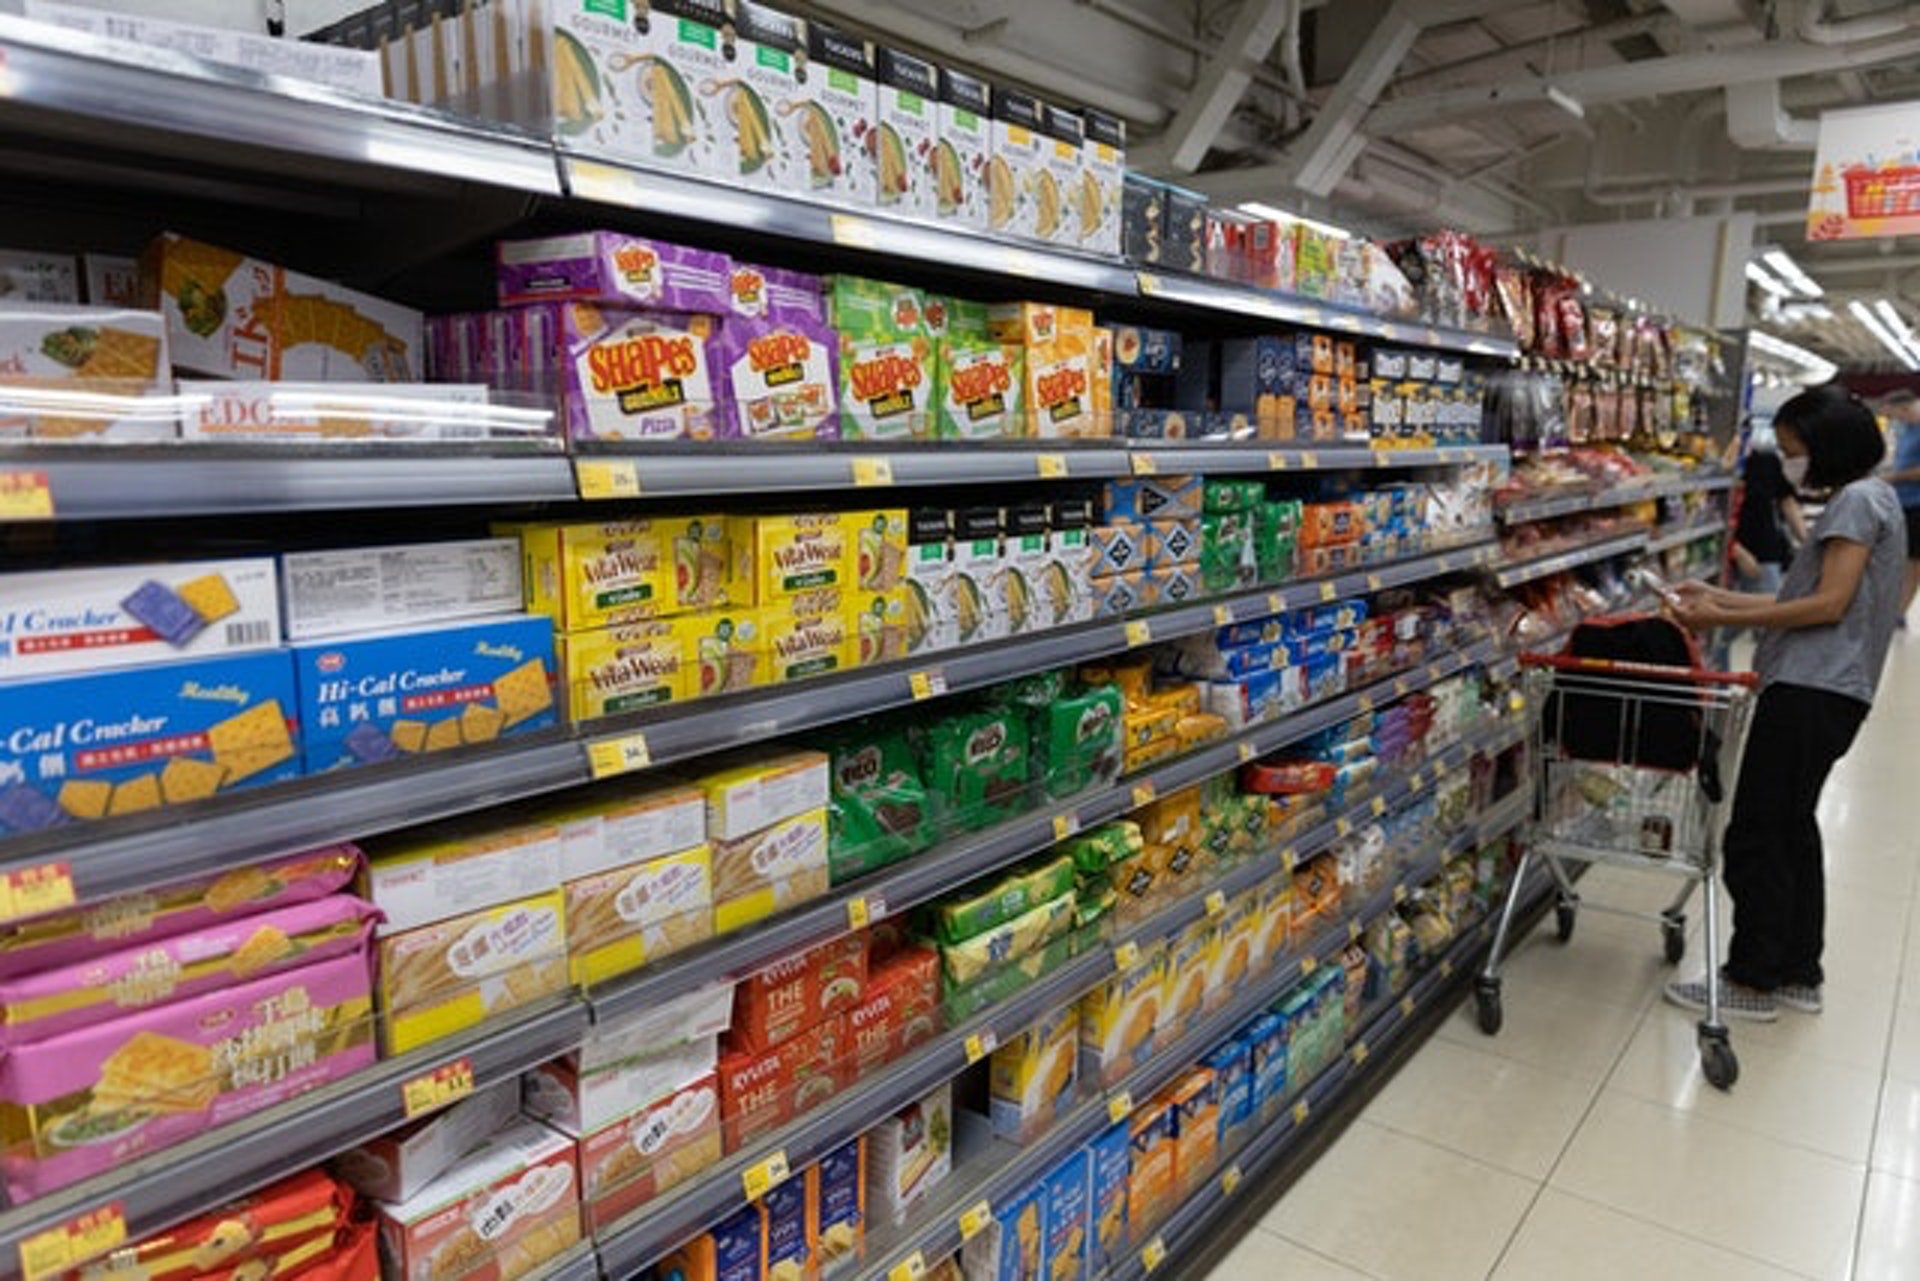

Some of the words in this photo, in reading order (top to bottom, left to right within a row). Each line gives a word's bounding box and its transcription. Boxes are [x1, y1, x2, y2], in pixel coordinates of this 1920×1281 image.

[318, 672, 397, 703] Hi-Cal
[400, 667, 467, 690] Cracker
[70, 714, 169, 745] Cracker
[767, 978, 804, 1011] THE
[737, 1079, 776, 1114] THE
